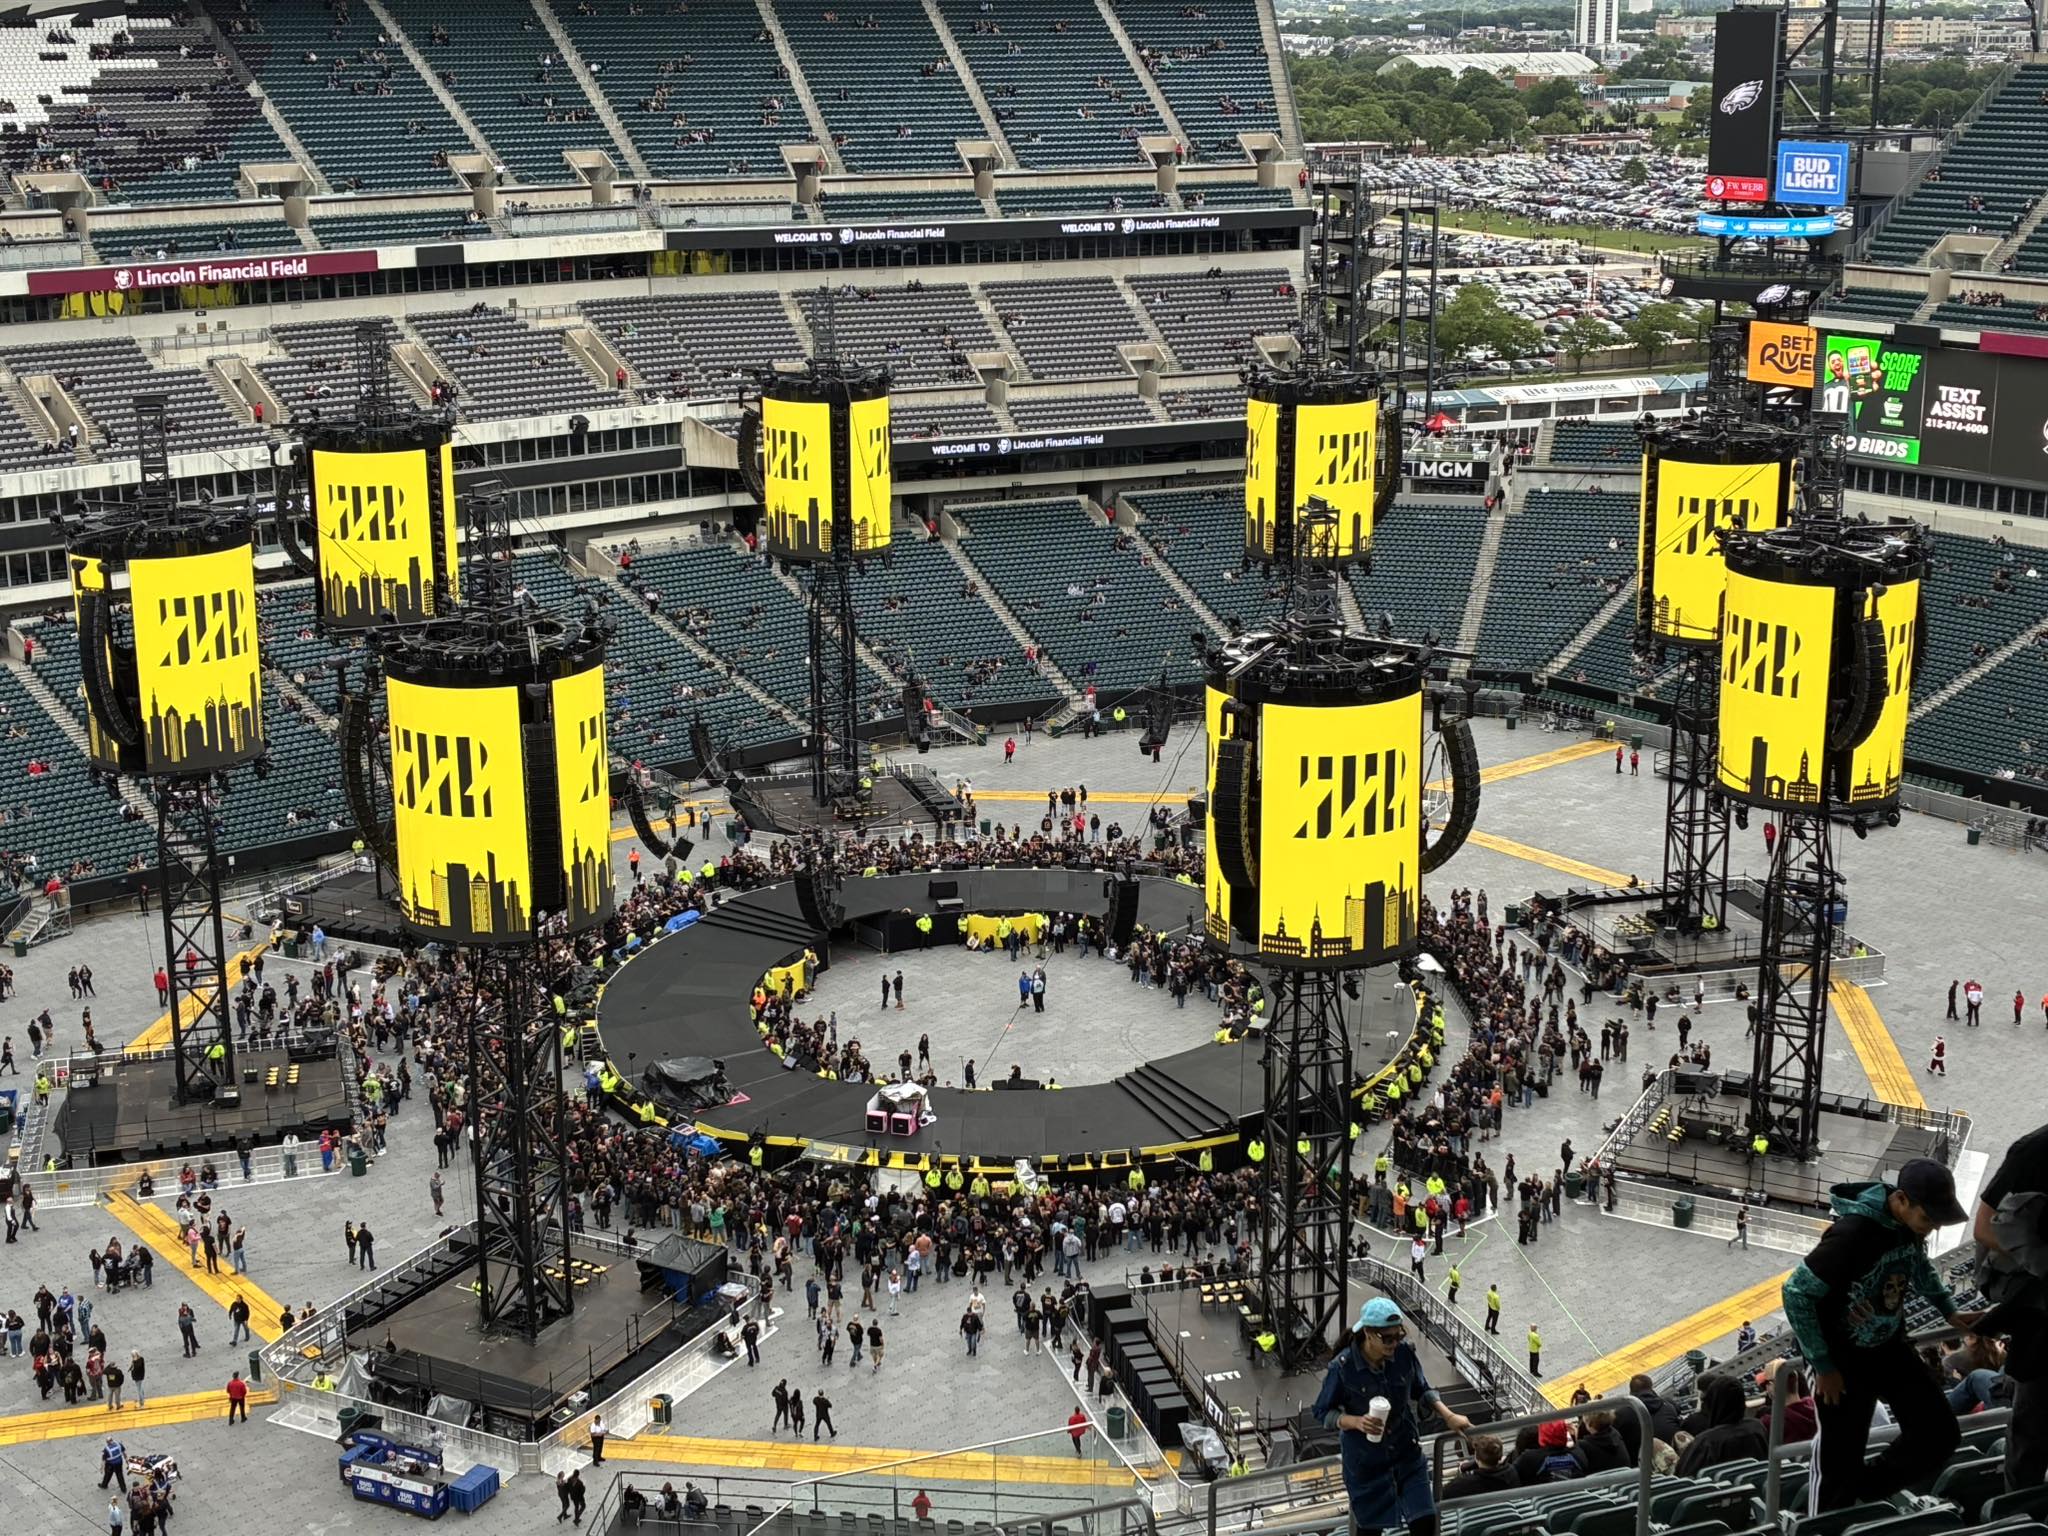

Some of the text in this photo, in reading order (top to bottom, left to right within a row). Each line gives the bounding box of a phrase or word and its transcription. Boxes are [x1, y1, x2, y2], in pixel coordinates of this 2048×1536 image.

[1793, 157, 1831, 174] BUD
[1785, 172, 1837, 190] LIGHT
[1061, 216, 1220, 233] WELCOME TO Lincoln Financial Field
[774, 227, 946, 243] WELCOME TO Lincoln Financial Field
[137, 258, 308, 286] Lincoln Financial Field
[1781, 335, 1814, 351] BET
[1760, 343, 1816, 375] RIVE
[1880, 351, 1922, 375] SCORE
[1554, 383, 1620, 395] FIELDHOUSE
[1884, 371, 1913, 391] BIG!
[1938, 385, 1981, 405] TEXT
[1930, 401, 1986, 421] ASSIST
[932, 434, 1104, 455] WELCOME TO Lincoln Financial Field
[1858, 437, 1909, 458] BIRDS
[1204, 1370, 1241, 1383] YETI
